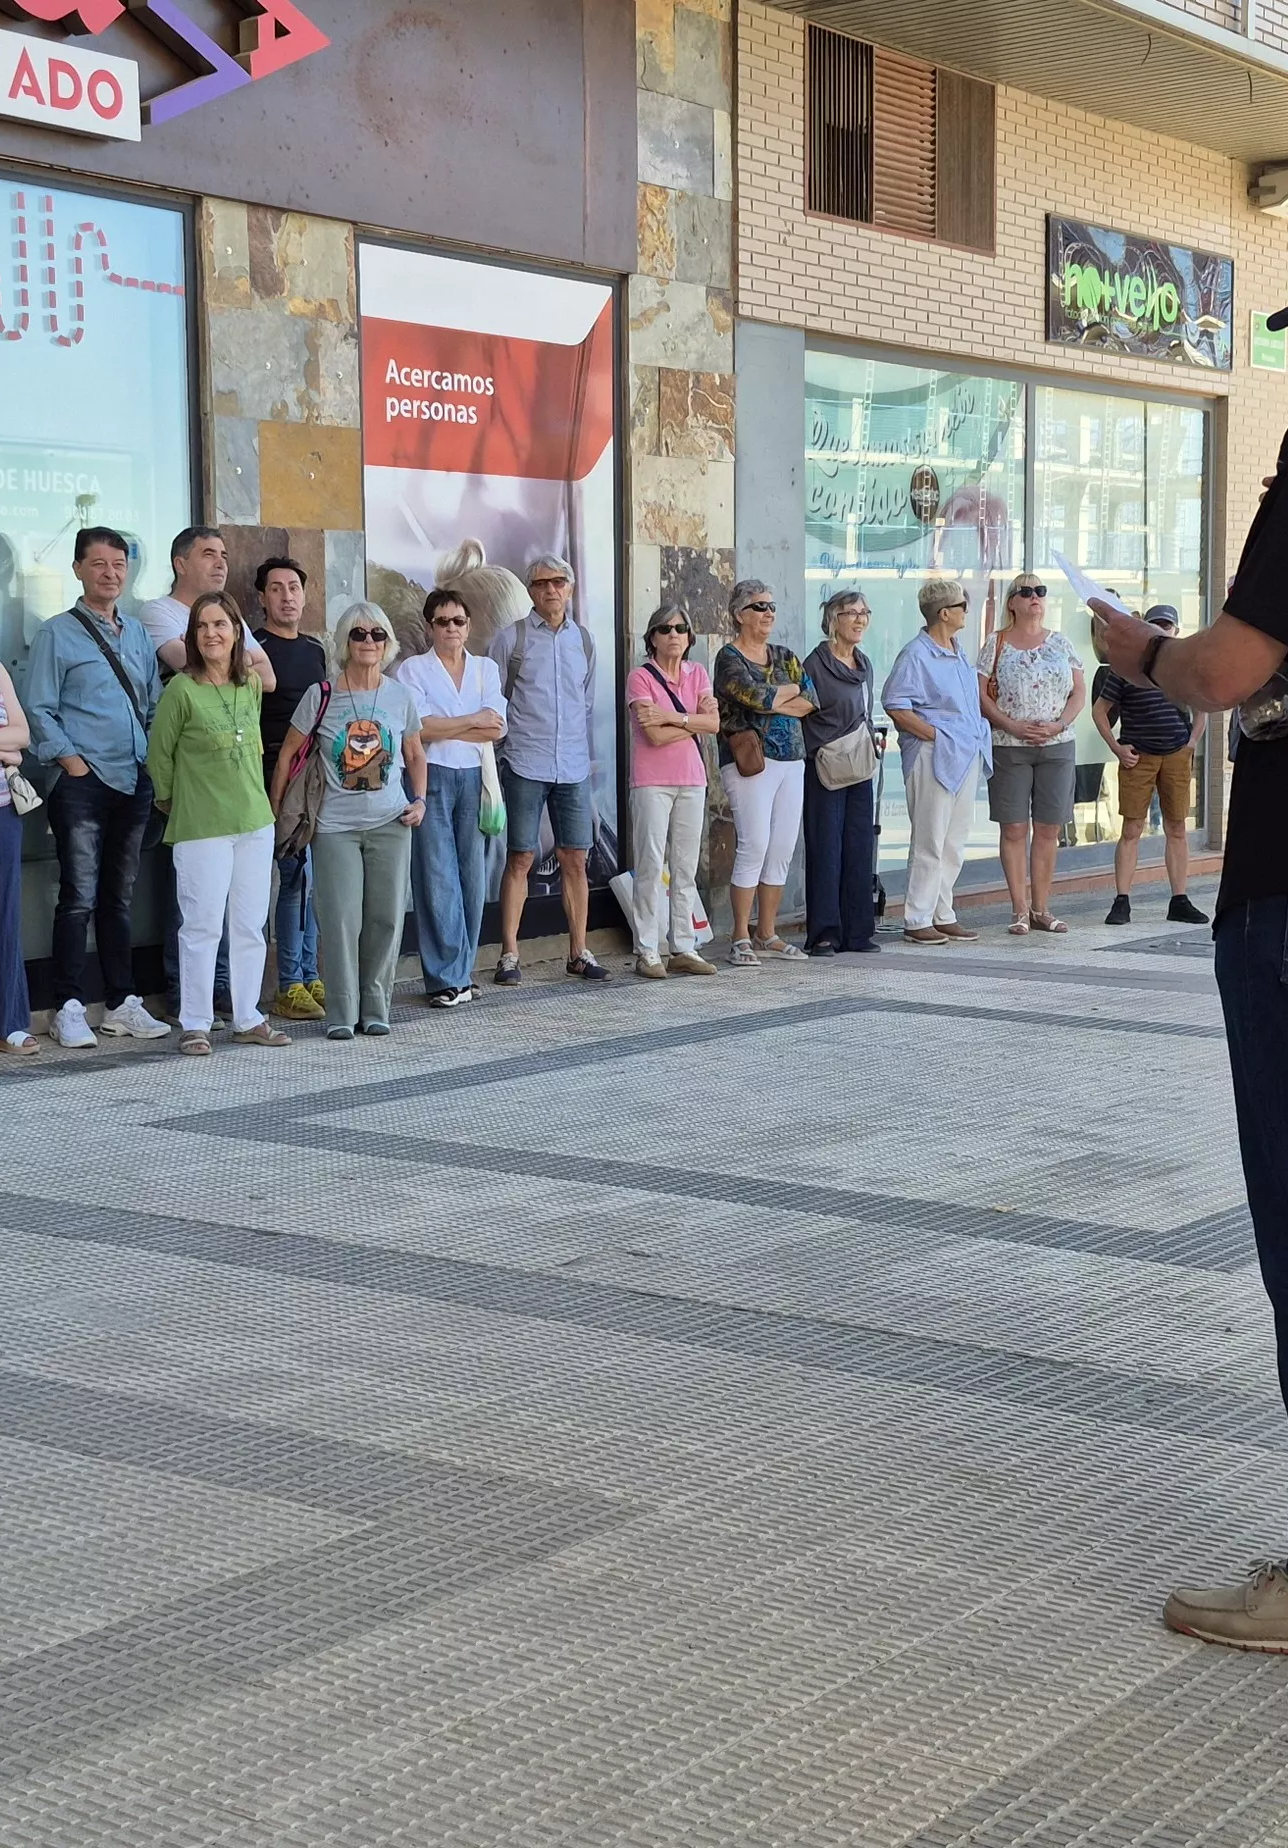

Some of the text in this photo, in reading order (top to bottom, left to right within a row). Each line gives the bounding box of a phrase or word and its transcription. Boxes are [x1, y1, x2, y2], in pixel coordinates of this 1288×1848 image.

[9, 46, 123, 120] ADO
[385, 358, 495, 396] Acercamos
[386, 397, 478, 425] personas
[23, 469, 103, 496] HUESCA
